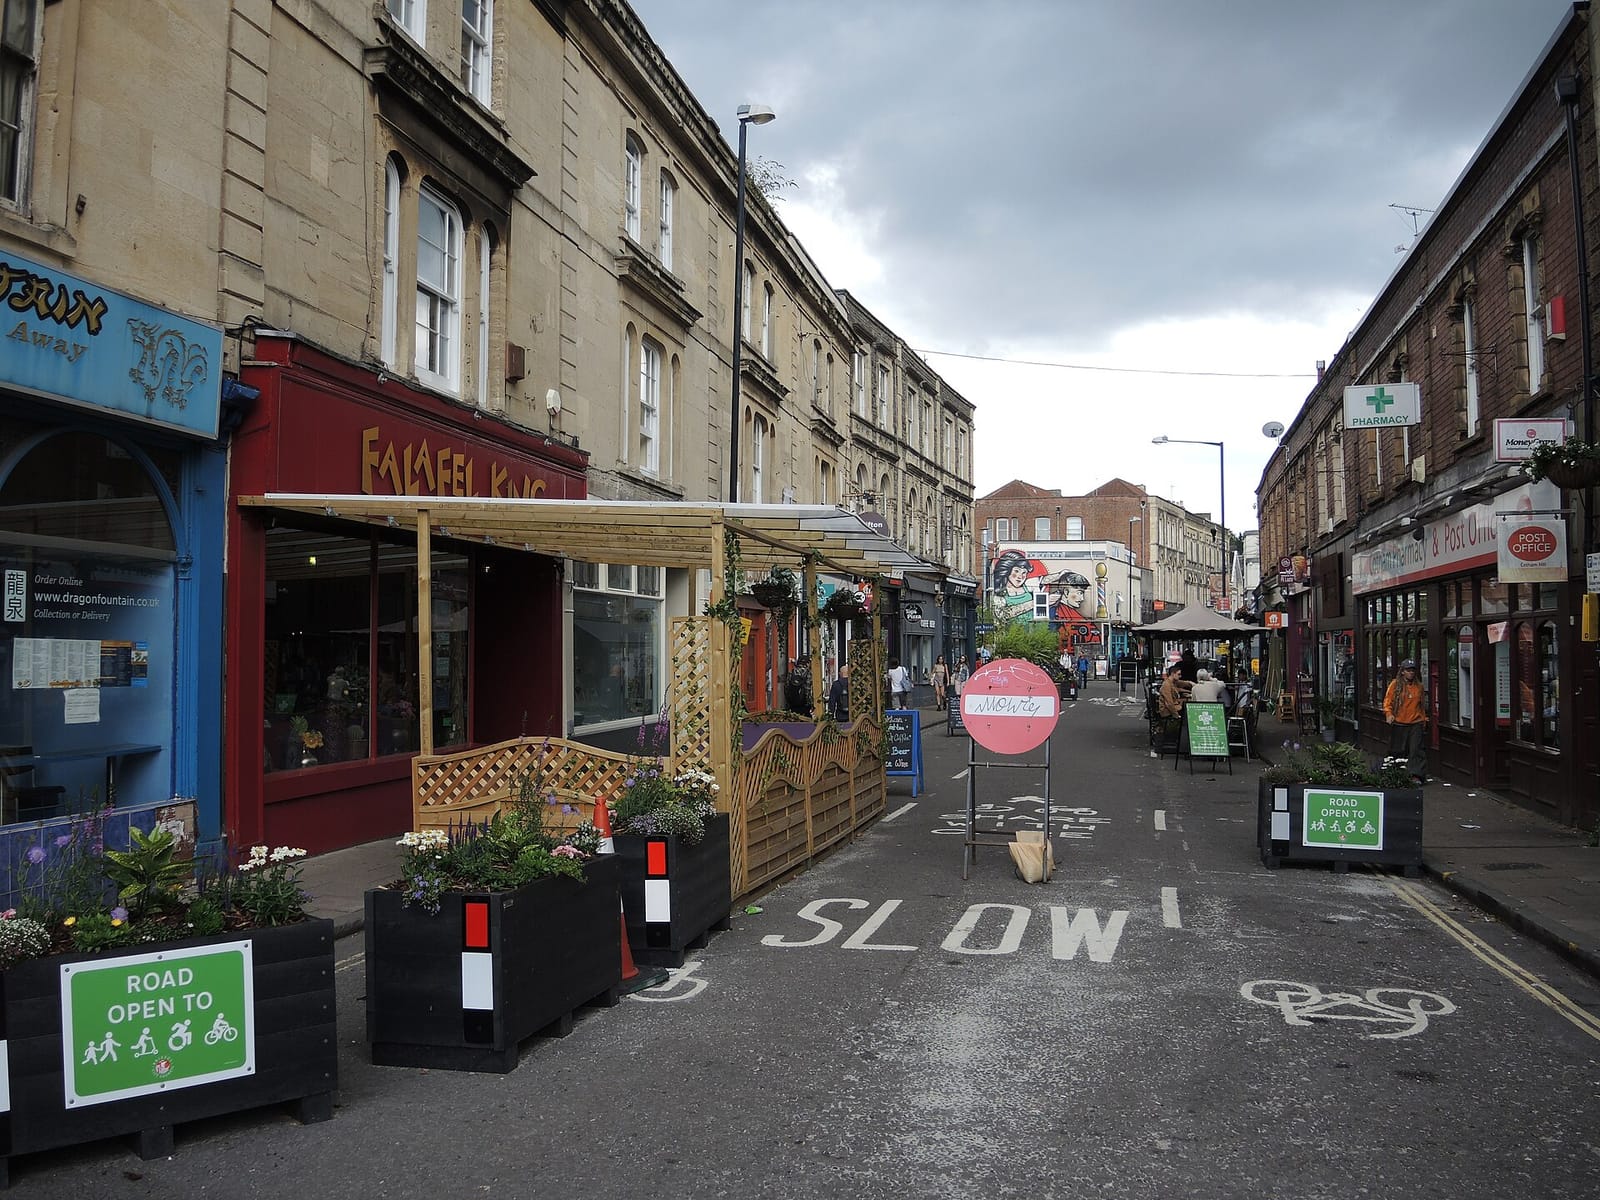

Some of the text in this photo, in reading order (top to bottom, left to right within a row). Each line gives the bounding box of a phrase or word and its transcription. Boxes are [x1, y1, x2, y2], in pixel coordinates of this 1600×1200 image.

[6, 320, 88, 363] Away
[1352, 415, 1408, 427] PHARMACY
[361, 426, 479, 497] FALAFEL
[1432, 527, 1440, 557] &
[1444, 521, 1466, 553] Post
[1468, 511, 1498, 547] Offic
[1519, 533, 1547, 543] POST
[1512, 543, 1552, 553] OFFICE
[34, 574, 84, 587] Order Online
[6, 572, 25, 619] 龍泉
[34, 591, 160, 608] www.dragonfountain.co.uk
[33, 608, 111, 622] Collection or Delivery
[1329, 798, 1358, 807] ROAD
[1320, 808, 1366, 819] OPEN TO
[760, 898, 1129, 963] SLOW
[127, 967, 194, 994] ROAD
[107, 990, 213, 1024] OPEN TO
